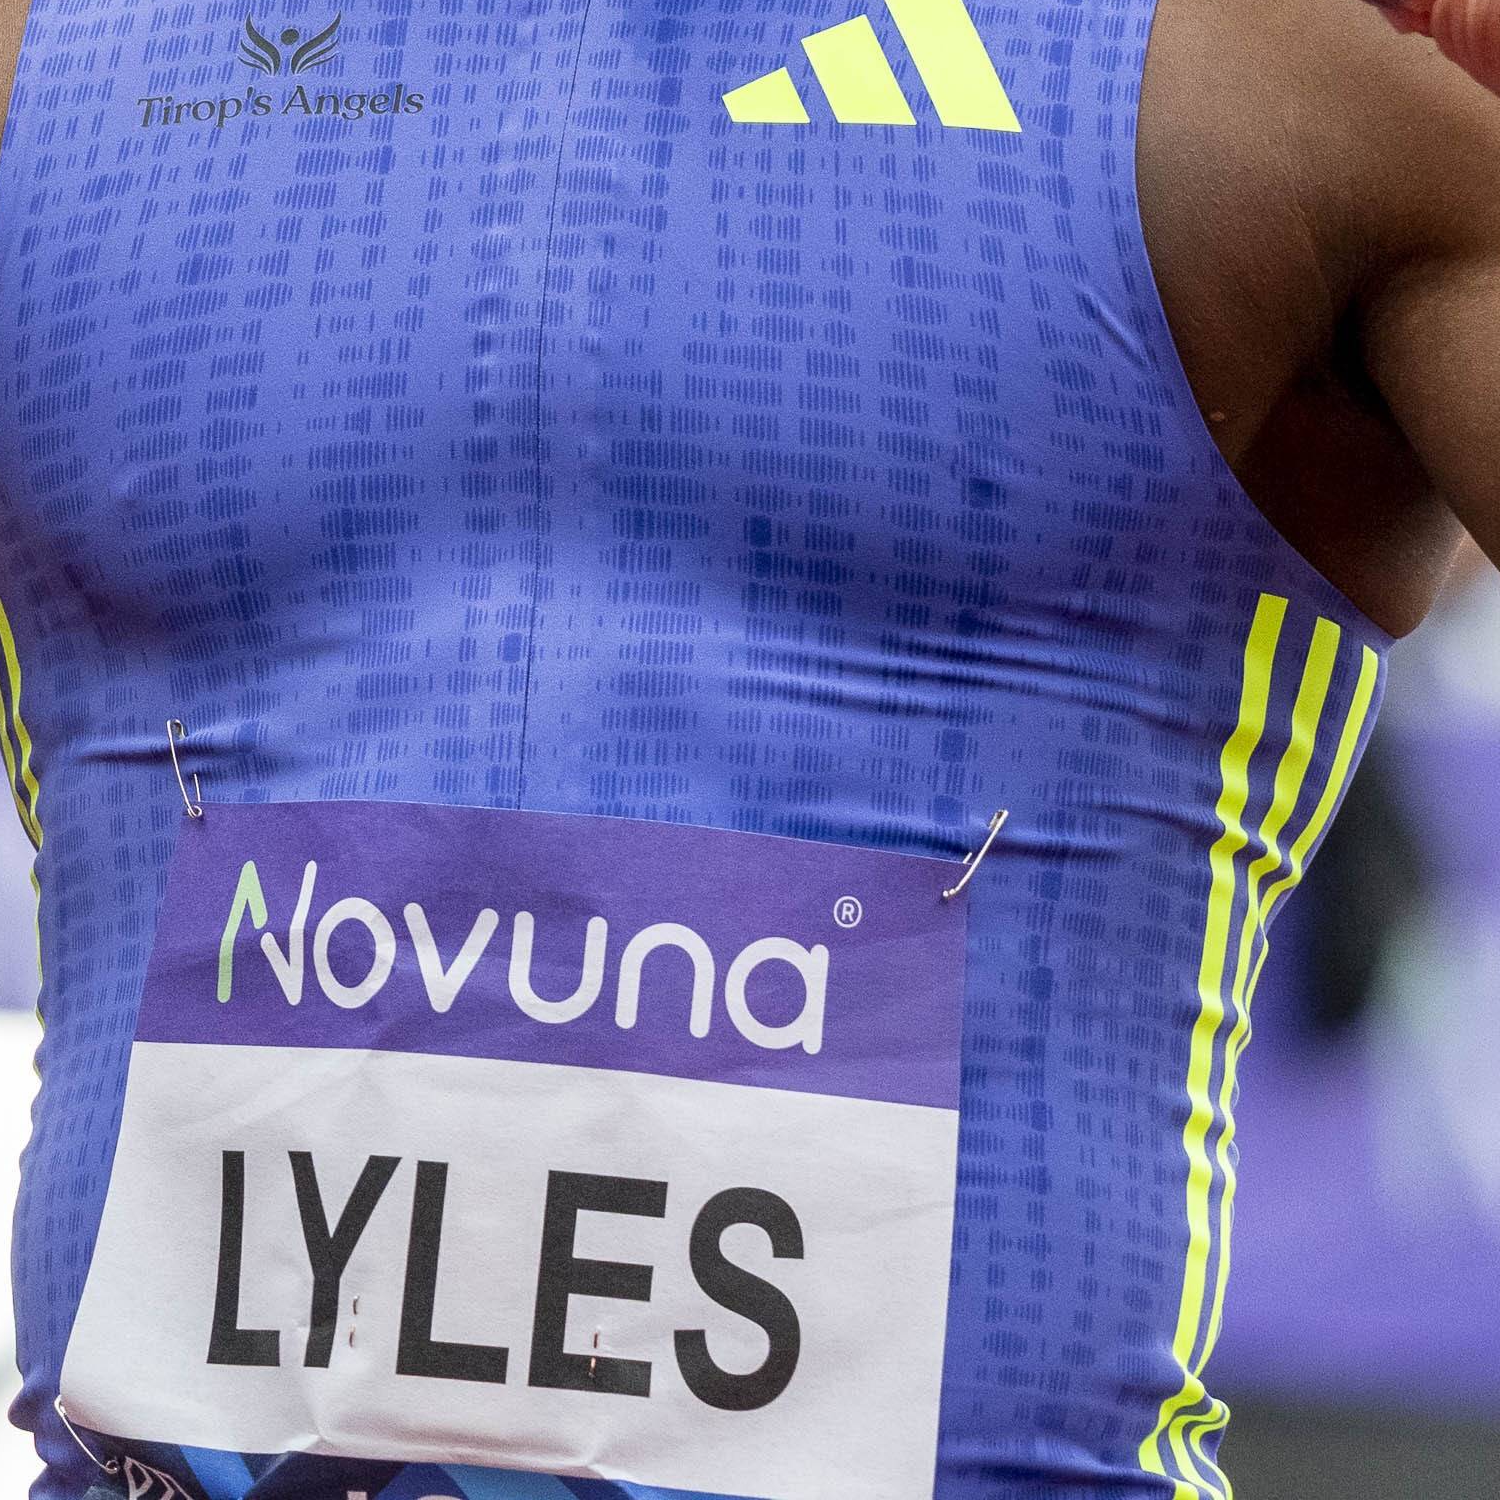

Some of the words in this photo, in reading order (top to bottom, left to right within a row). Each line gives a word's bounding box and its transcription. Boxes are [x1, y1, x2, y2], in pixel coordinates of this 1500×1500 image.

[138, 86, 272, 128] Tirop's
[282, 84, 425, 121] Angels
[206, 1150, 805, 1412] LYLES
